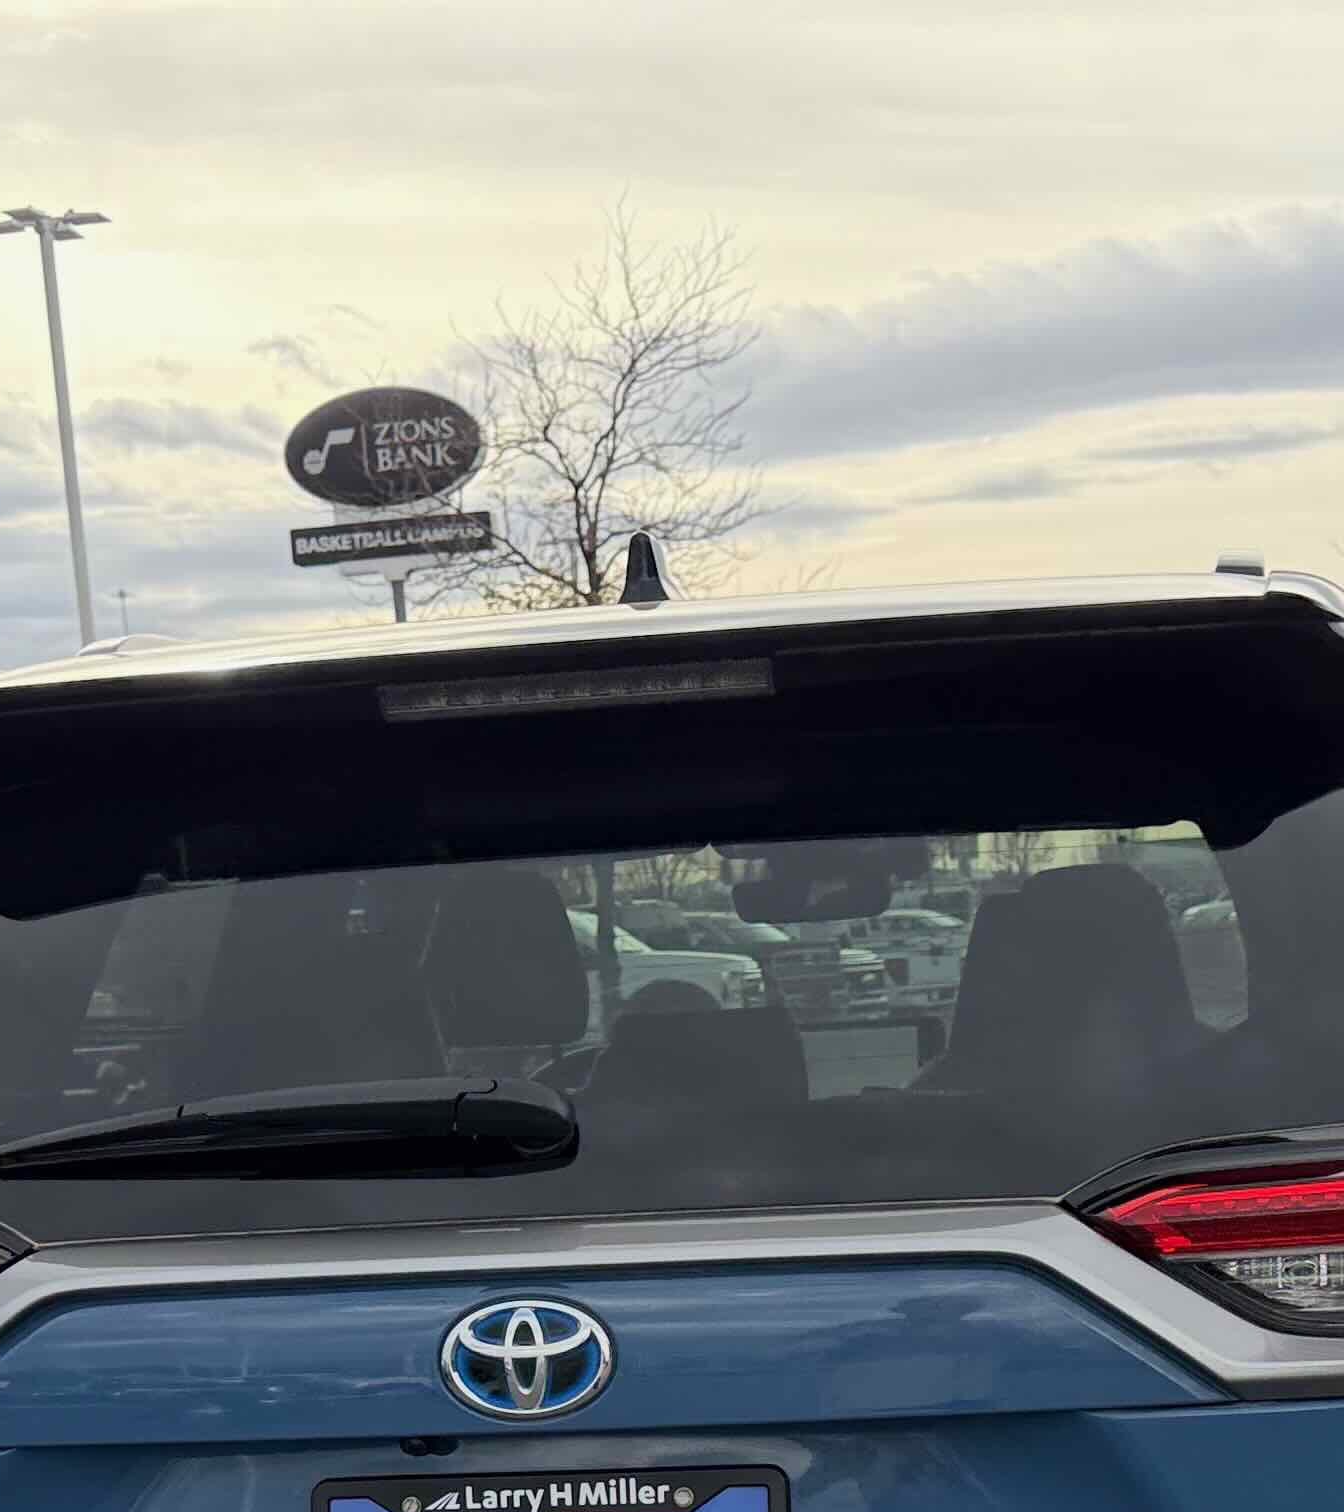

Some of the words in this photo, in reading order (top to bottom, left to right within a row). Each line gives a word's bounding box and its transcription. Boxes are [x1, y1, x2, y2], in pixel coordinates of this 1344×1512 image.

[372, 416, 456, 446] ZIONS
[376, 444, 457, 473] BANK
[295, 530, 408, 555] BASKETBALL
[465, 1485, 544, 1512] Larry
[550, 1482, 573, 1507] H
[578, 1478, 670, 1506] Miller
